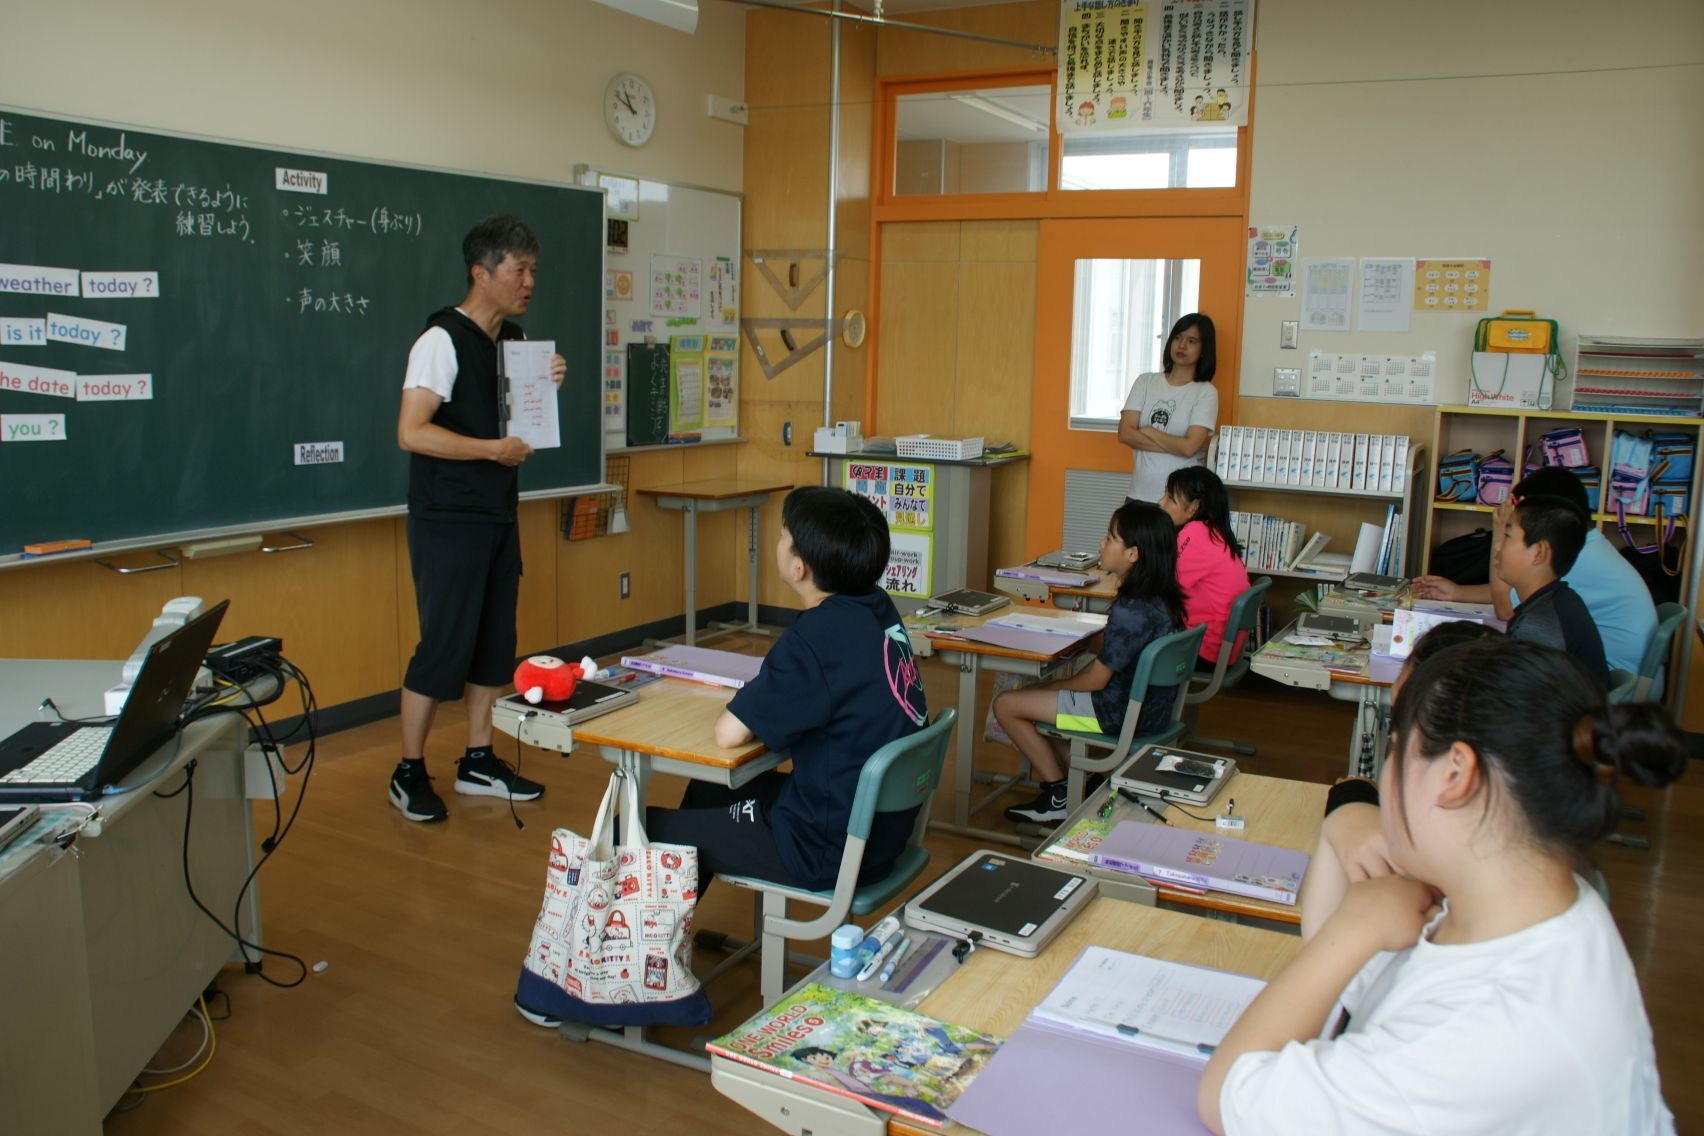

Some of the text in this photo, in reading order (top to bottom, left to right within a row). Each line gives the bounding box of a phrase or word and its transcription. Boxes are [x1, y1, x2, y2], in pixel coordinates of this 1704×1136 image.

[32, 135, 55, 151] on
[68, 129, 148, 174] Monday
[282, 169, 323, 192] Activity
[296, 239, 342, 266] 笑顔
[88, 278, 137, 296] today
[298, 287, 371, 316] 声の大きさ
[6, 324, 22, 341] is
[28, 324, 43, 341] it
[50, 321, 101, 345] today
[28, 376, 70, 395] date
[82, 381, 132, 398] today
[8, 422, 41, 440] you
[300, 443, 339, 463] Reflection
[894, 468, 926, 483] 課題
[894, 484, 926, 497] 自分で
[894, 498, 926, 511] みんなで
[886, 564, 918, 579] シェアリング
[886, 577, 917, 593] 流れ
[728, 1004, 808, 1051] ONE WORLD
[747, 1023, 814, 1060] Smiles
